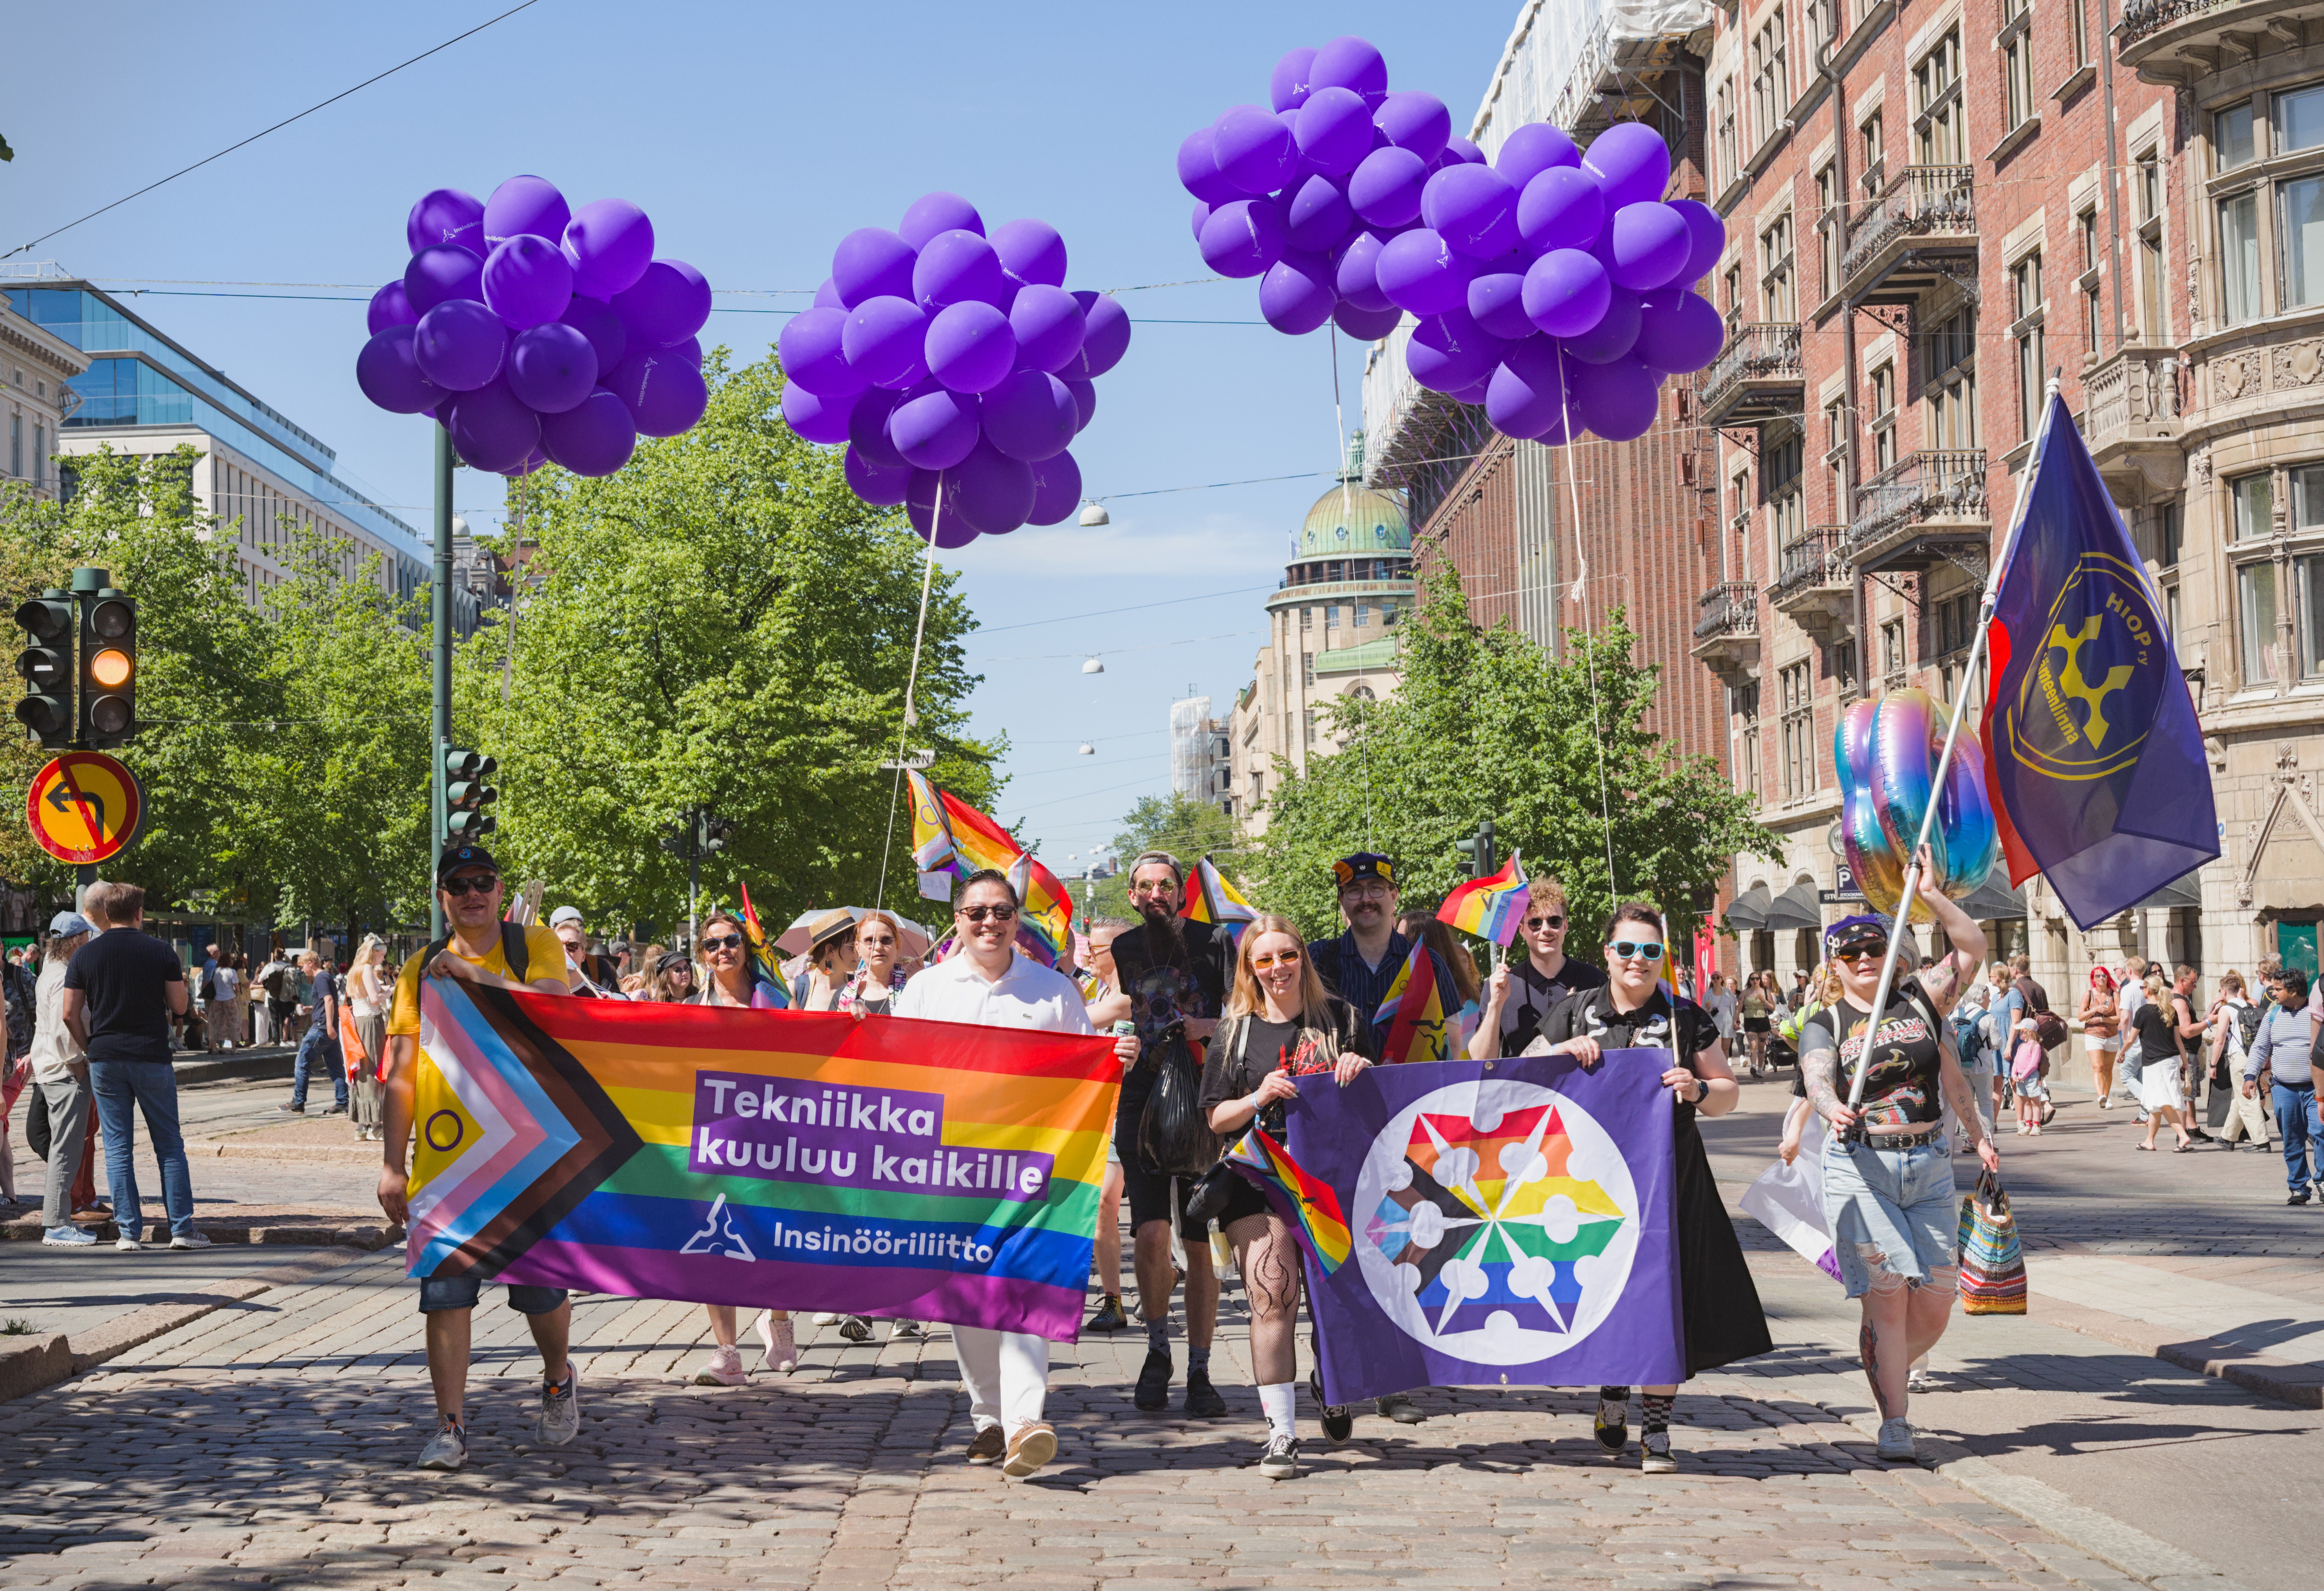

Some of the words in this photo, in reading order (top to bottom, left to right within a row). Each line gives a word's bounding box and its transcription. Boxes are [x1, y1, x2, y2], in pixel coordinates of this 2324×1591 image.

[1245, 215, 1258, 248] Insinööriliitto
[1479, 207, 1507, 236] Insinööriliitto
[638, 368, 652, 407] Insinööriliitto
[2105, 592, 2152, 646] HIOP
[2137, 651, 2148, 666] ry
[2038, 652, 2079, 745] ämeenlinna
[1839, 871, 1851, 888] P
[704, 1078, 935, 1137] Tekniikka
[696, 1127, 857, 1178] kuuluu
[872, 1145, 1044, 1195] kaikille
[773, 1221, 994, 1264] Insinööriliitto
